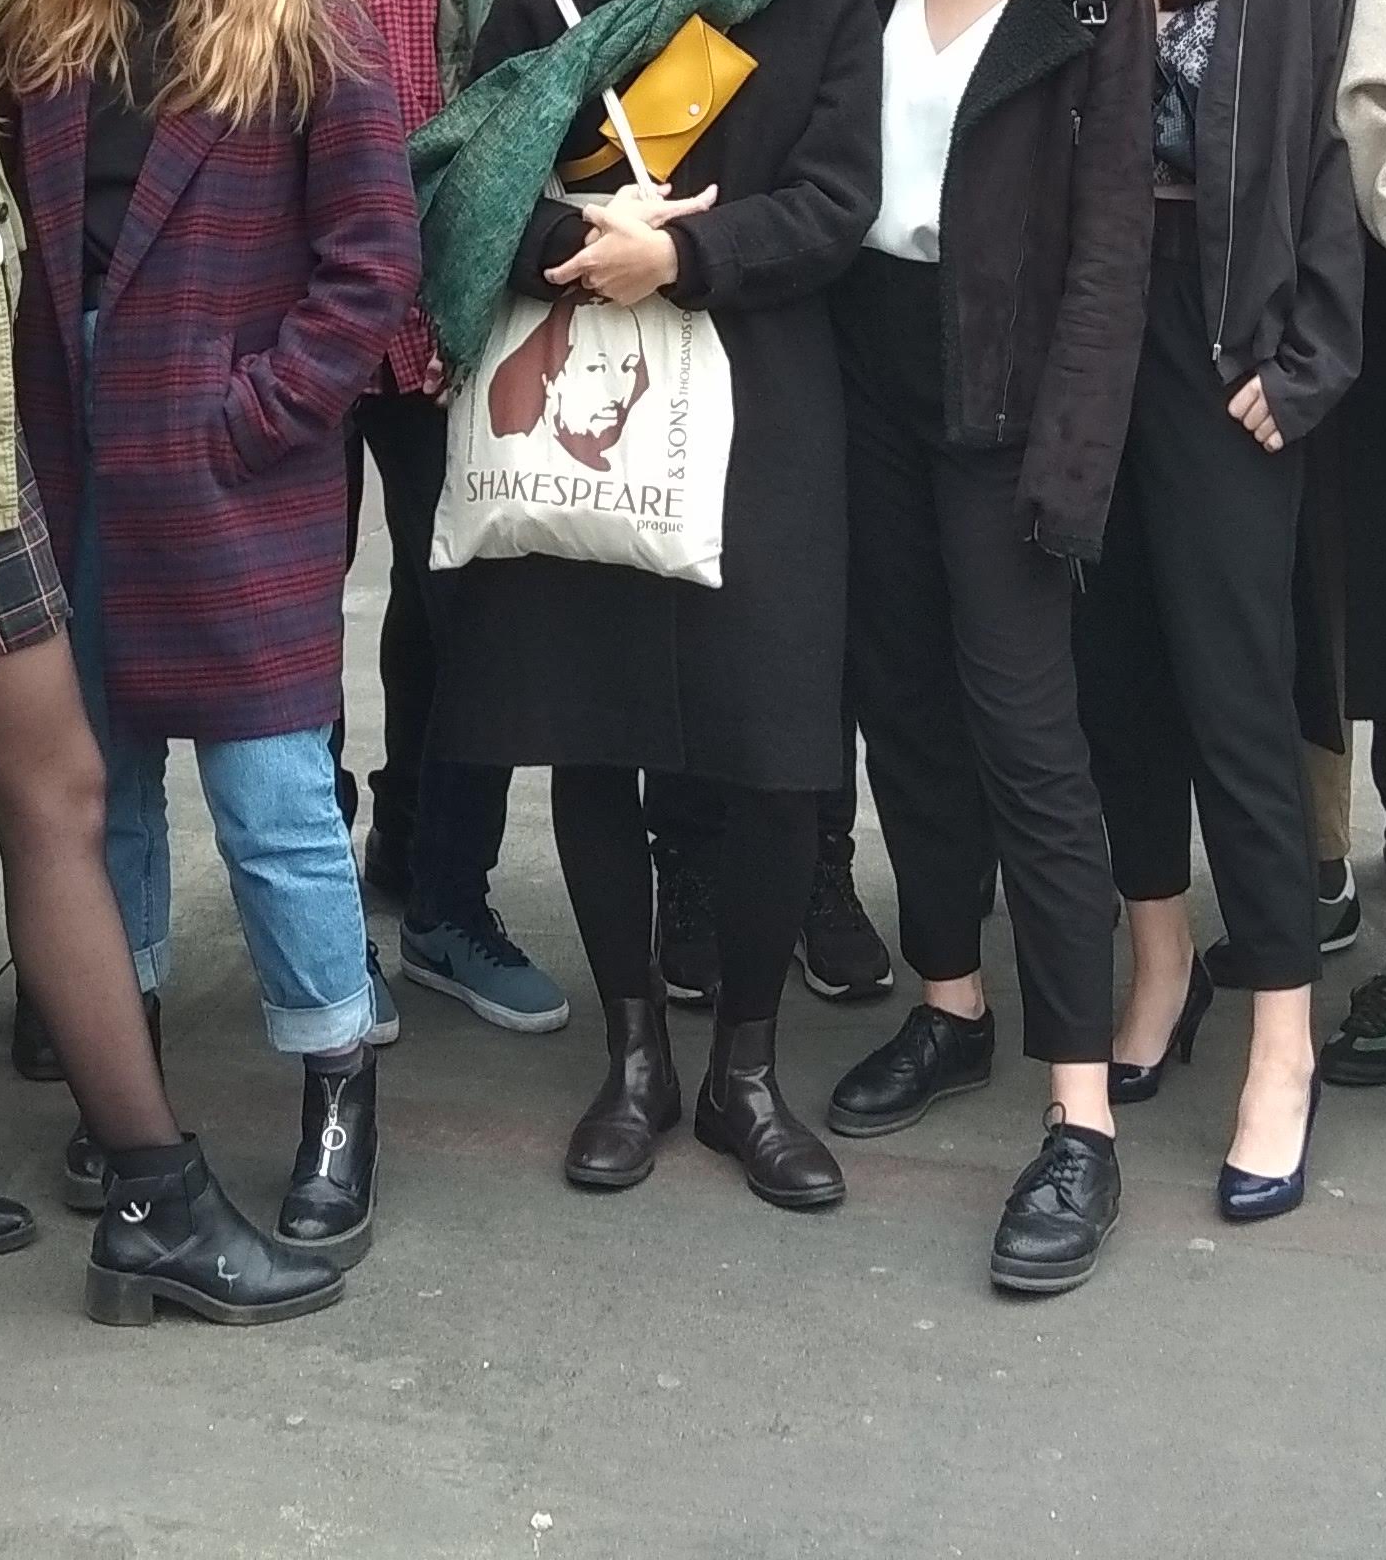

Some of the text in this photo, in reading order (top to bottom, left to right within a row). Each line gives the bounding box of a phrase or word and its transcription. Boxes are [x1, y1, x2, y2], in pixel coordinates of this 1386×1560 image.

[668, 397, 689, 462] SONS
[668, 467, 686, 481] &
[465, 469, 685, 519] SHAKESPEARE
[636, 518, 684, 535] prague
